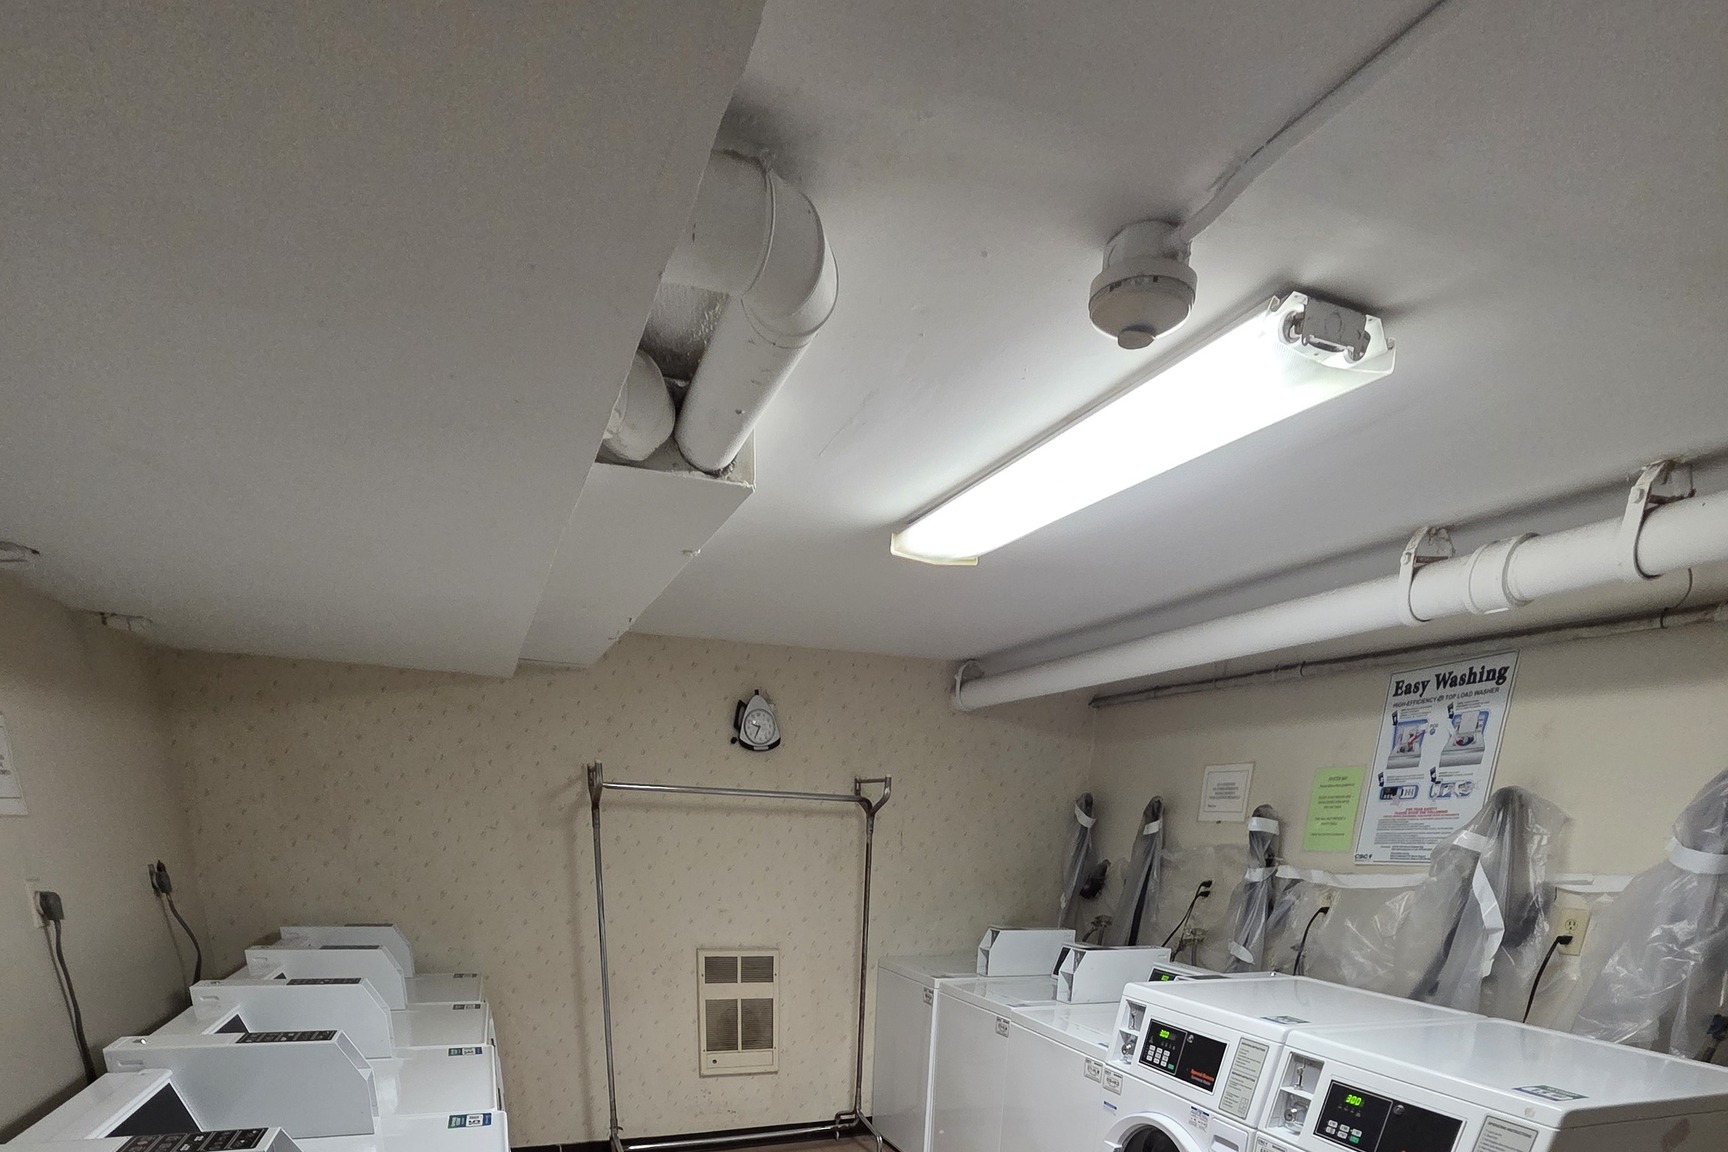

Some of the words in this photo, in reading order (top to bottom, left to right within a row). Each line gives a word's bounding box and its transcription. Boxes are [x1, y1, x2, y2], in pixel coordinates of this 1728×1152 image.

[1393, 680, 1431, 697] Easy
[1435, 665, 1510, 690] Washing
[1457, 691, 1473, 699] LOAD
[1474, 686, 1500, 696] WASHER
[1345, 1094, 1362, 1106] 300
